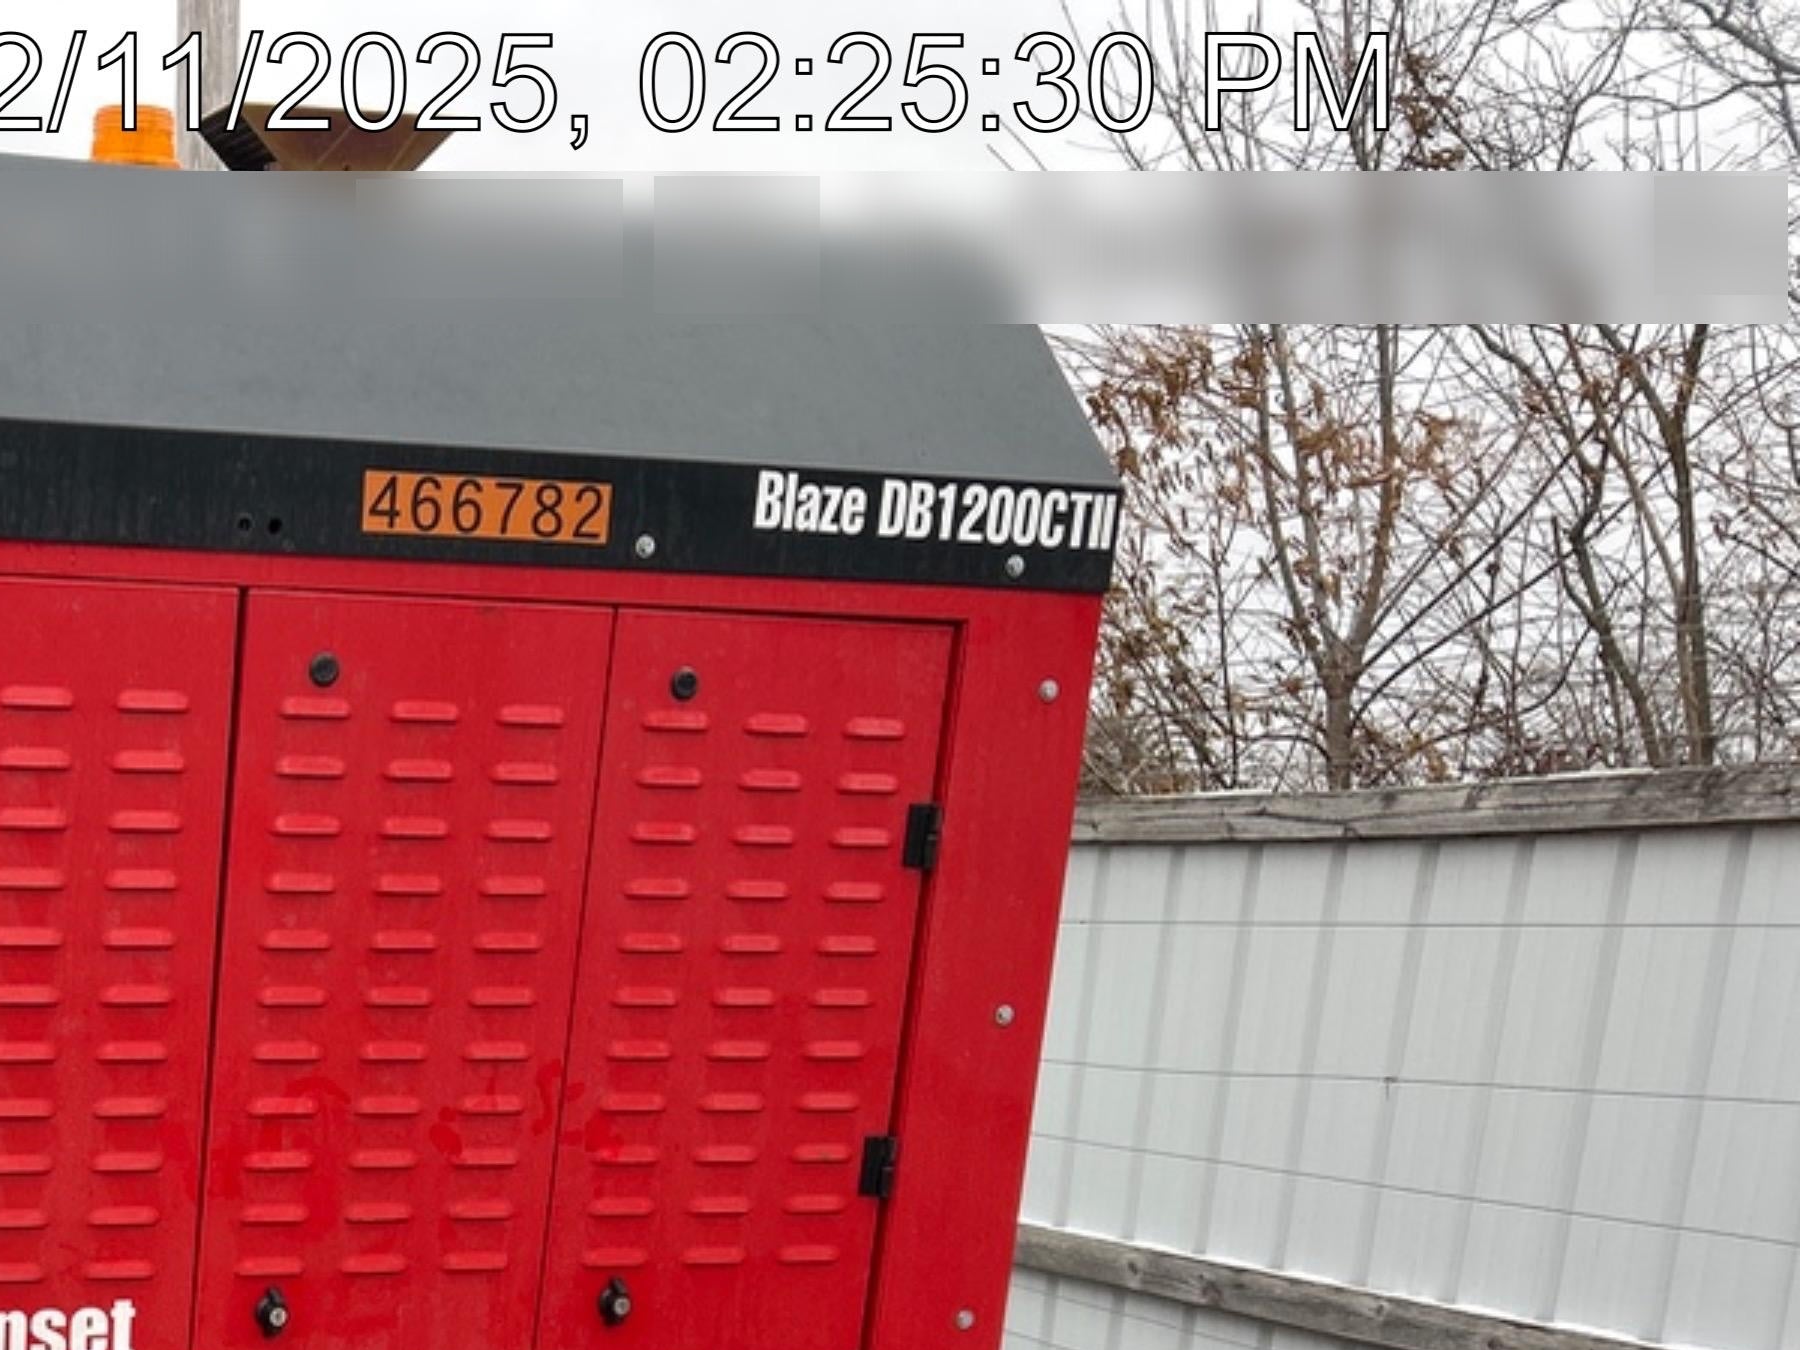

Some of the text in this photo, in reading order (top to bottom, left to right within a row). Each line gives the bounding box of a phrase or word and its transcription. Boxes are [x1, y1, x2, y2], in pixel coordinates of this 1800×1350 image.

[368, 475, 604, 539] 466782
[752, 469, 1117, 551] Blaze DB1200CTII
